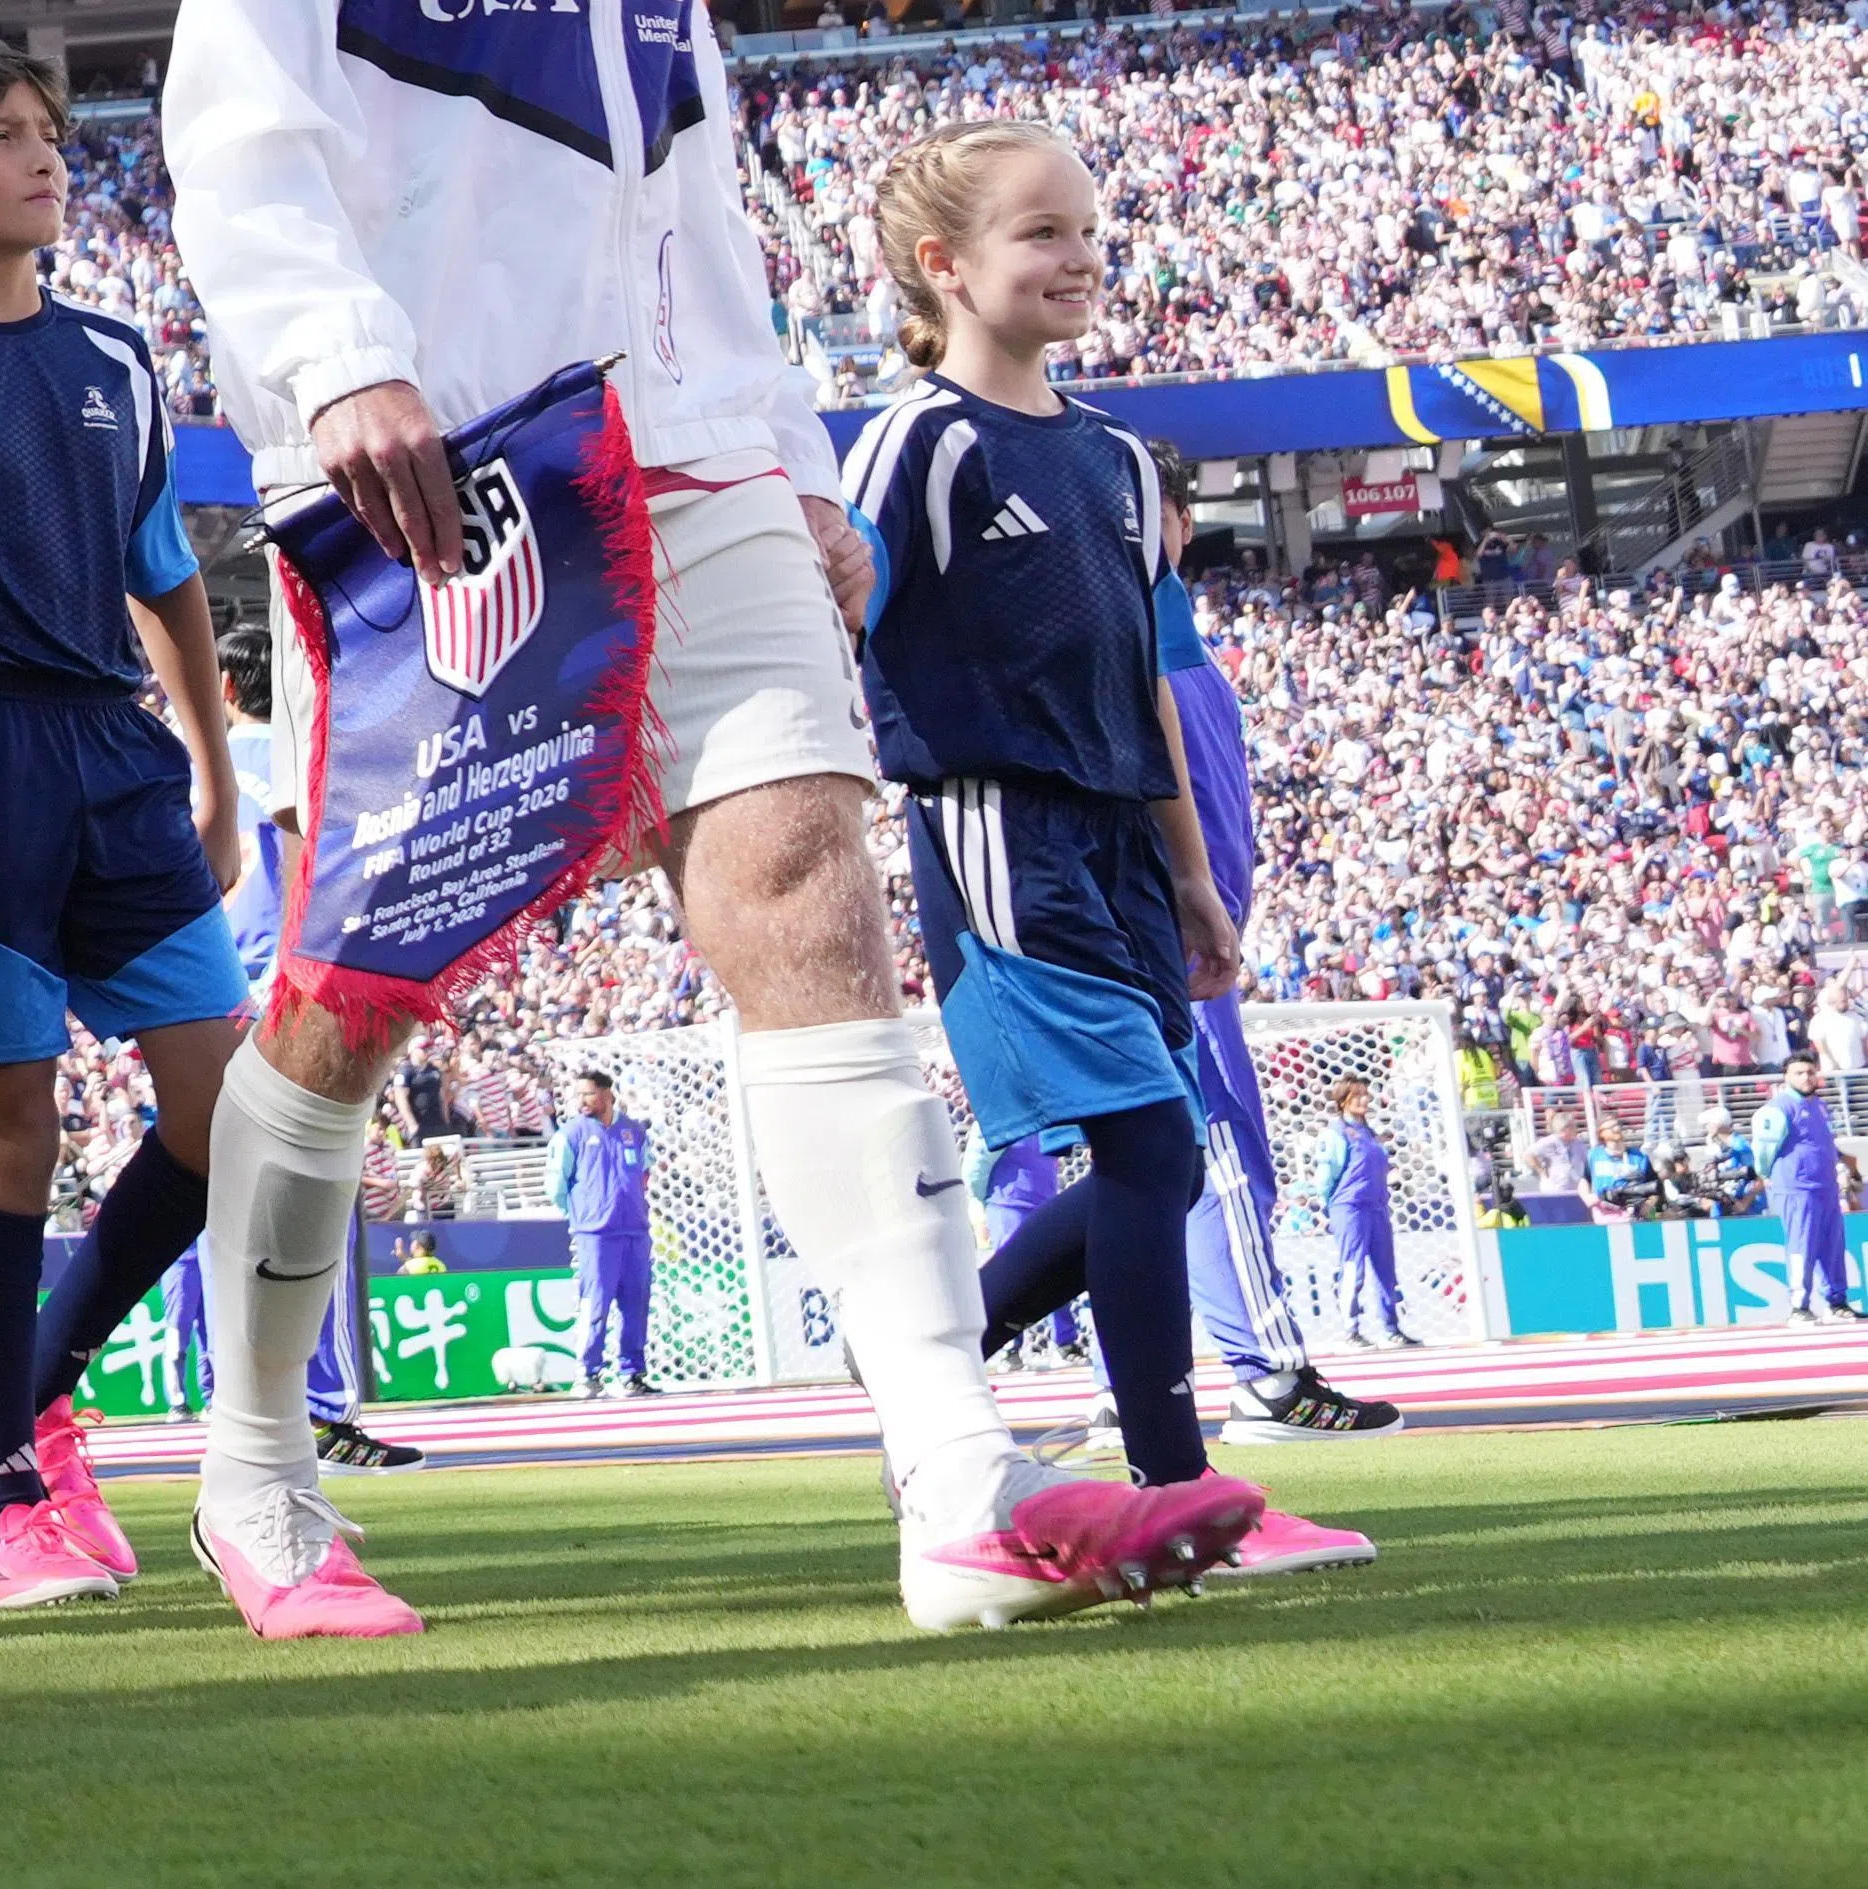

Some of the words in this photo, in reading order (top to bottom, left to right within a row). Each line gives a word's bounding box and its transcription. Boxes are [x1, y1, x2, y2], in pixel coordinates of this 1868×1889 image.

[1345, 485, 1380, 505] 106
[1382, 483, 1415, 503] 107
[416, 714, 487, 779] USA
[508, 705, 539, 735] vs
[352, 791, 422, 849] Bosnia
[422, 767, 463, 822] and
[465, 721, 595, 802] Herzegovina
[363, 845, 405, 880] FIFA
[410, 816, 469, 860] World
[474, 805, 513, 834] Cup
[515, 777, 569, 817] 2026
[408, 846, 464, 884] Round
[468, 840, 487, 861] of
[488, 828, 512, 853] 32
[341, 914, 371, 934] San
[373, 888, 439, 922] Francisco
[441, 878, 467, 898] Bay
[467, 867, 502, 887] Area
[505, 838, 566, 873] Stadium
[369, 915, 413, 941] Santa
[457, 871, 529, 908] California
[399, 921, 431, 946] July
[446, 902, 487, 927] 2026
